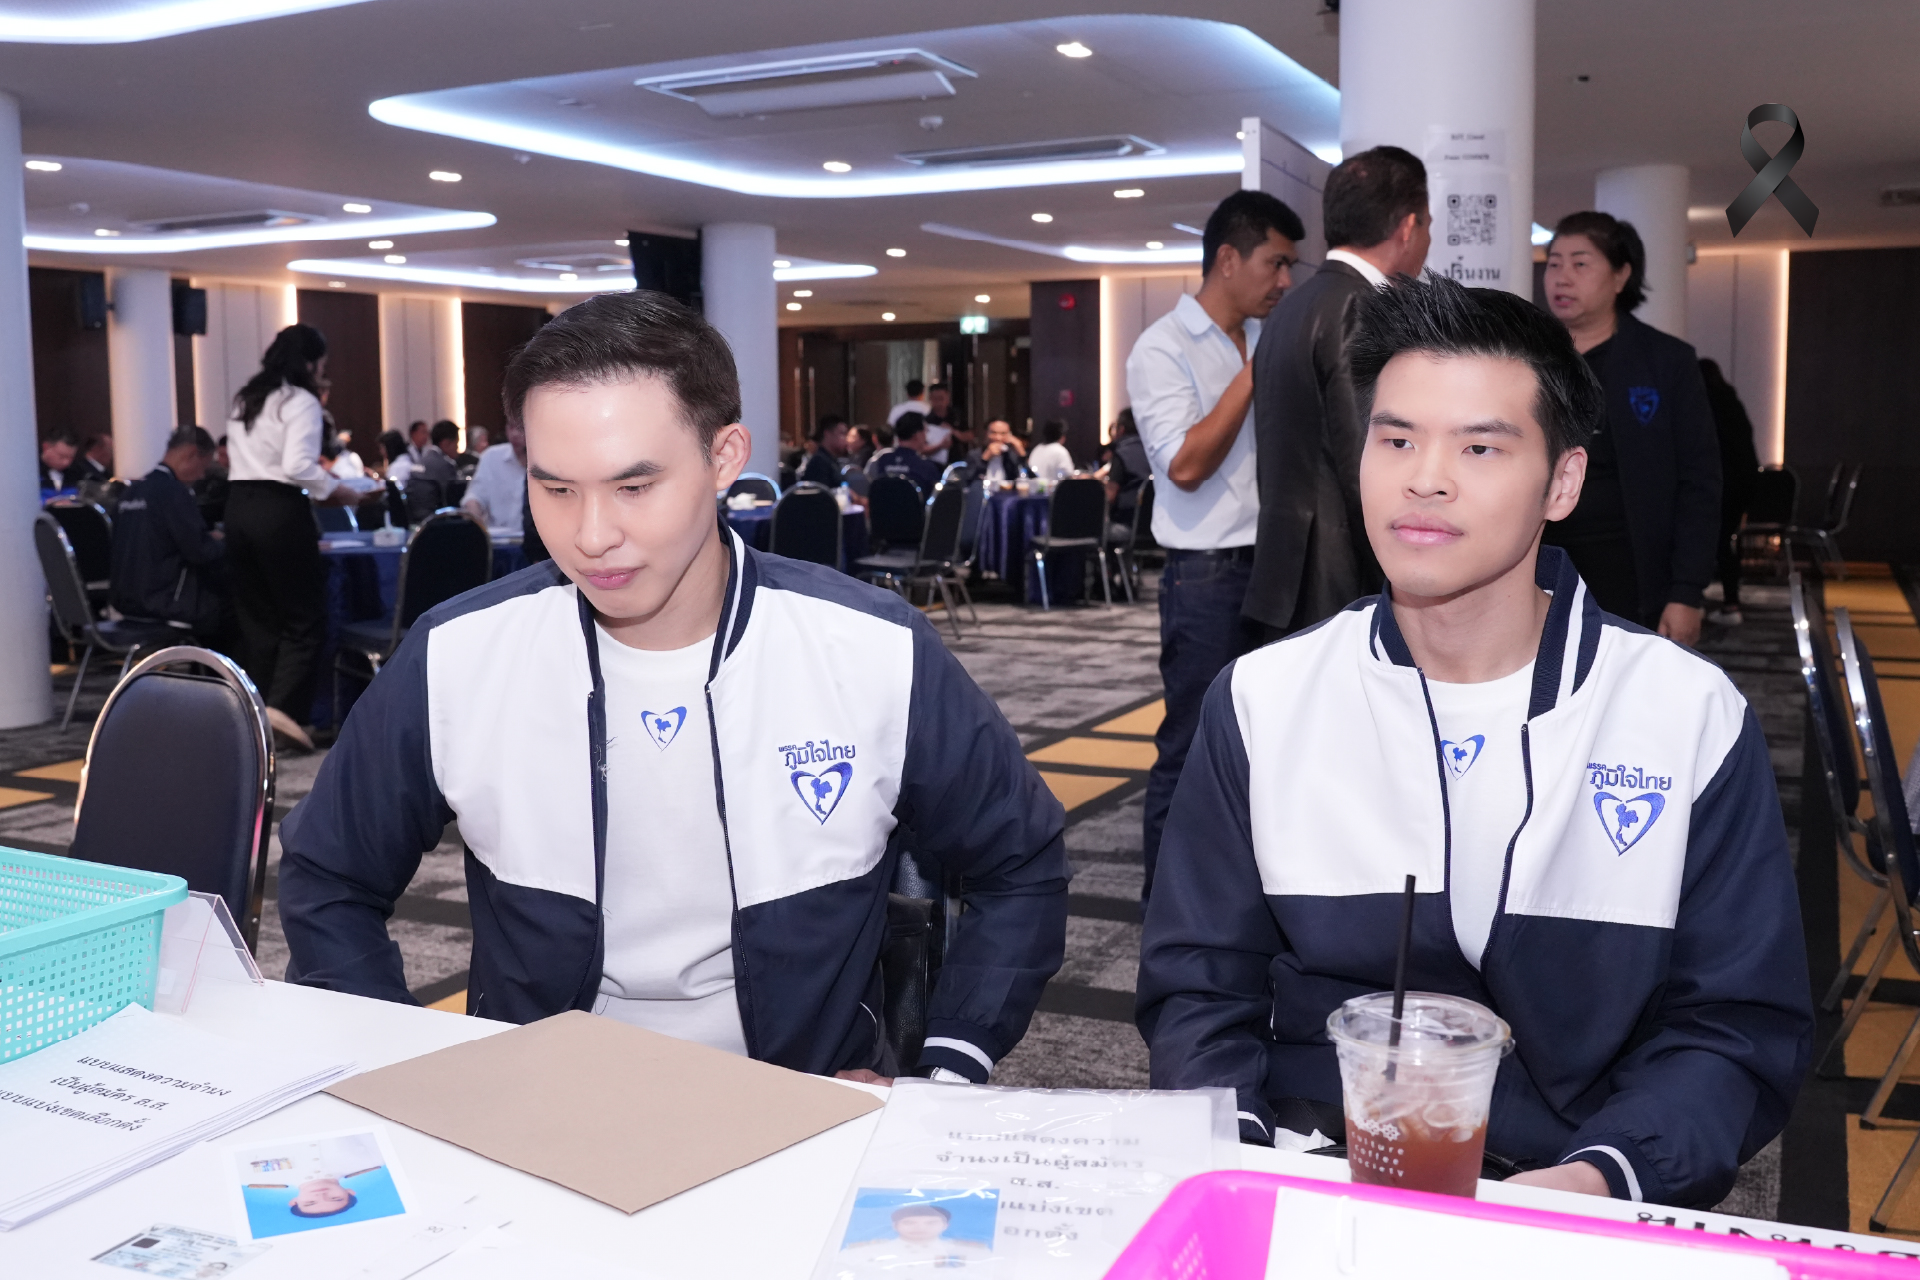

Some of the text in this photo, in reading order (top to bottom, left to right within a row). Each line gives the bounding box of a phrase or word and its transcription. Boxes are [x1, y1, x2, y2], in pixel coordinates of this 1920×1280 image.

[778, 744, 798, 753] พรรค
[784, 739, 856, 770] ภูมิใจไทย
[1589, 764, 1672, 791] ภูมิใจไทย
[76, 1055, 232, 1097] แบบแสดงความจำนง
[49, 1075, 136, 1103] เป็นผู้สมัคร
[1351, 1131, 1405, 1156] culture
[1354, 1144, 1399, 1166] coffee
[935, 1150, 1146, 1170] จำนงเป็นผู้สมัคร
[1352, 1153, 1405, 1178] society
[1003, 1222, 1079, 1241] อกตั้ง
